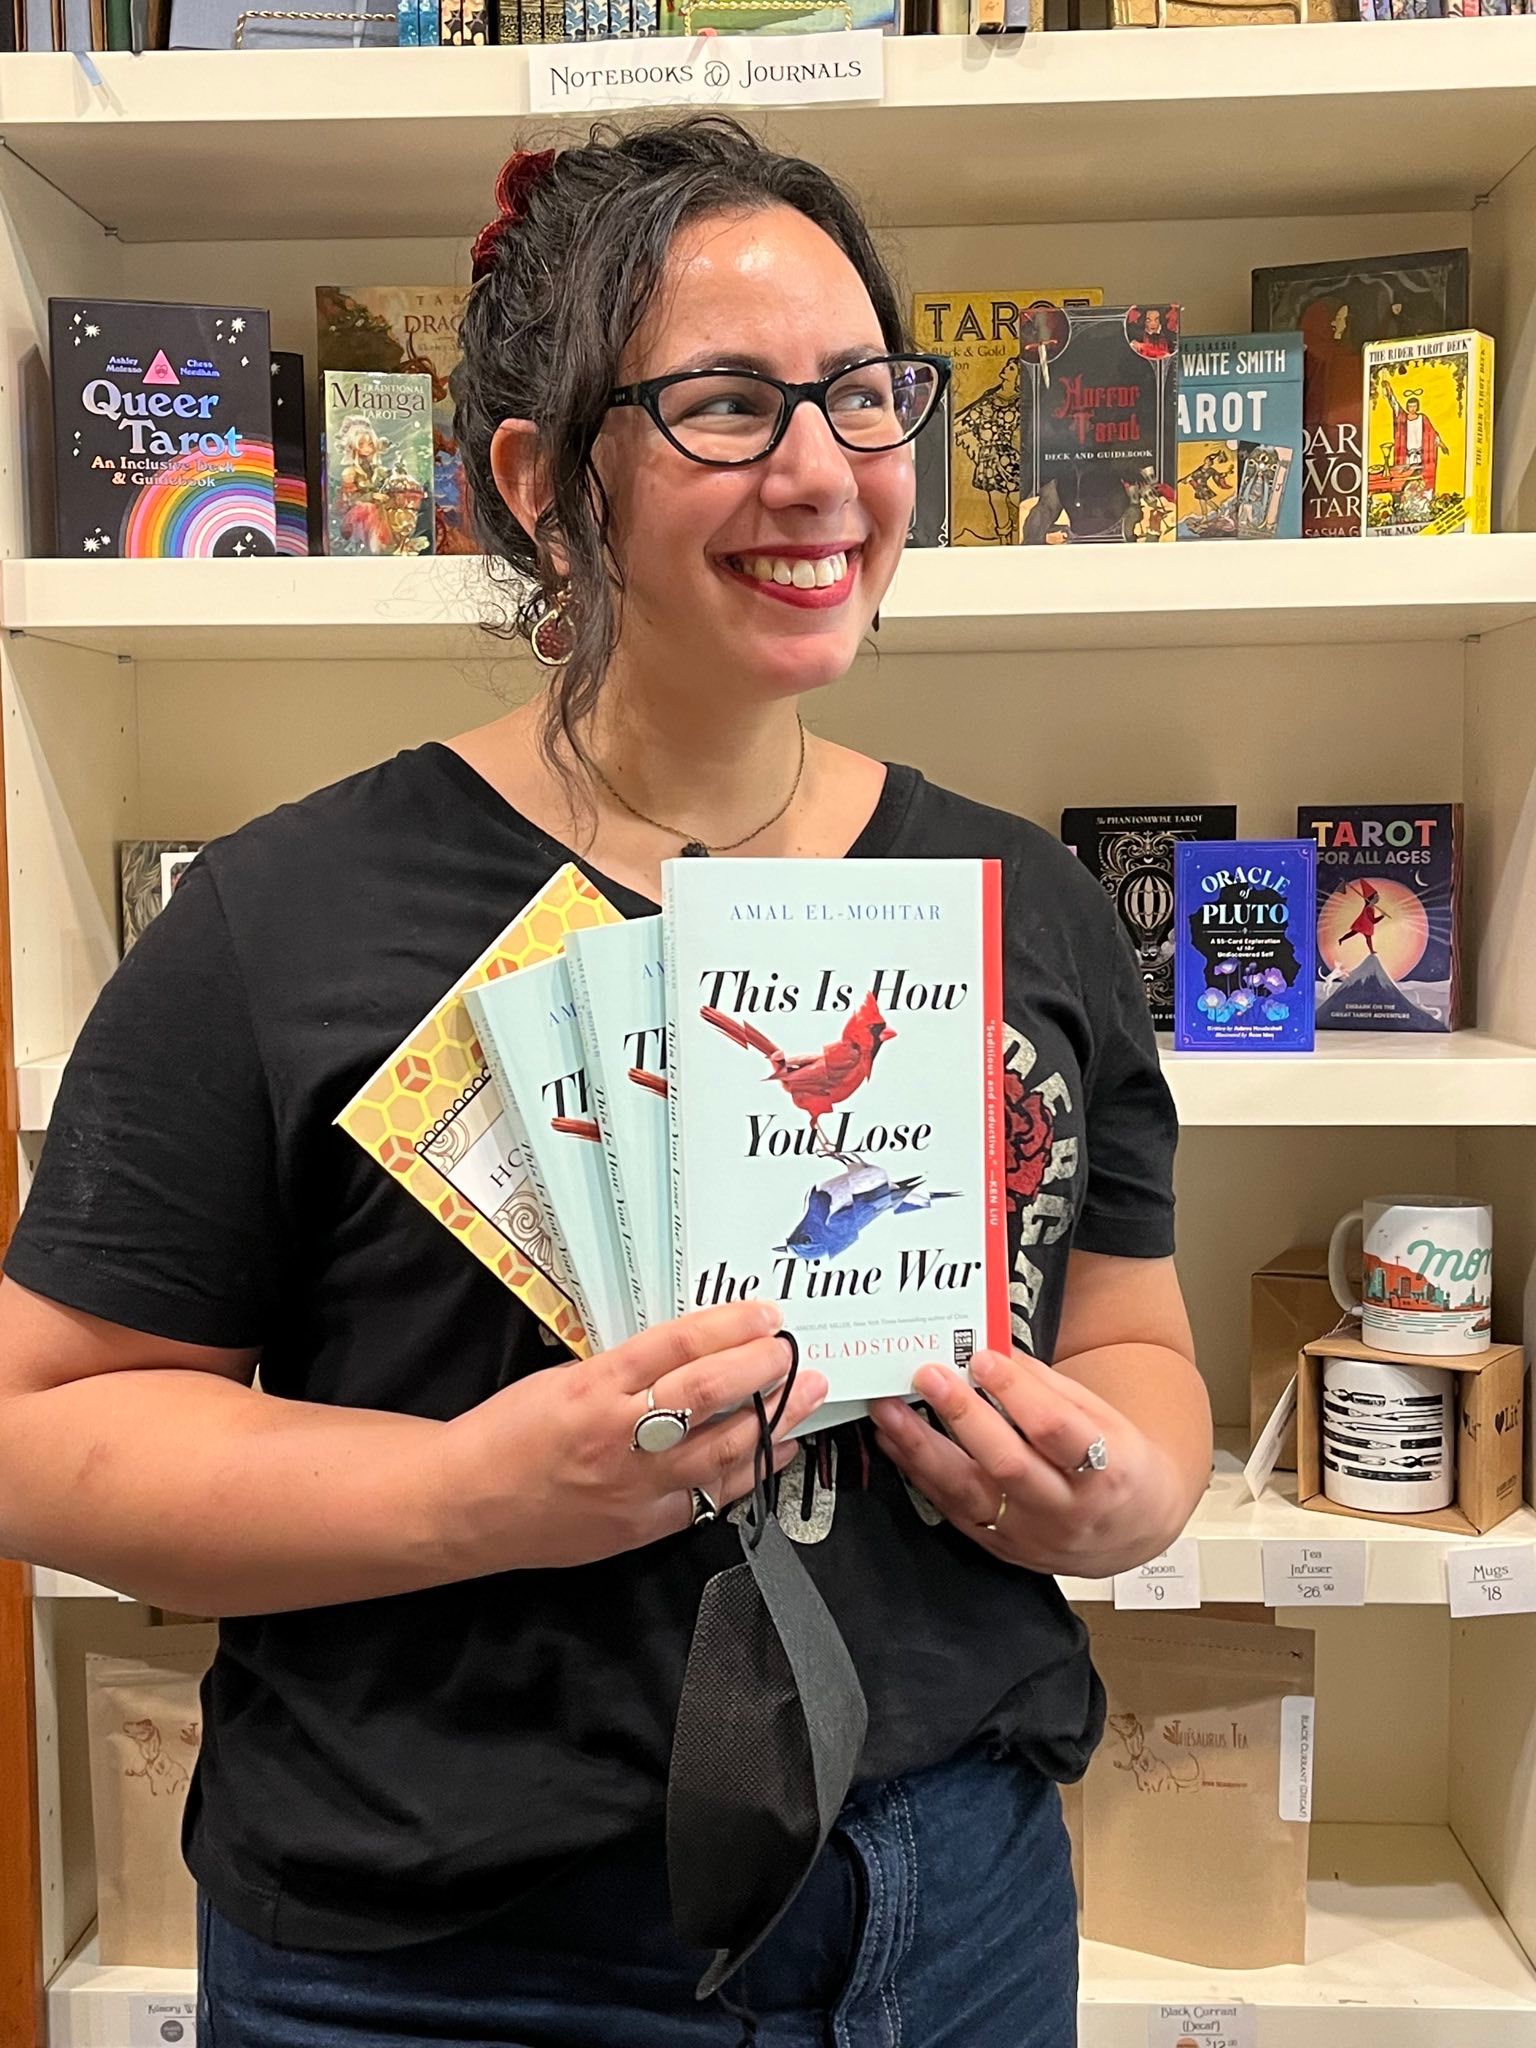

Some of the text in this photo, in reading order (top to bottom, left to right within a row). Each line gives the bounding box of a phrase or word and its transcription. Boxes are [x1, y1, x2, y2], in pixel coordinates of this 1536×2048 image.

[550, 64, 693, 95] NOTEBOOKS
[739, 60, 862, 89] JOURNALS
[978, 345, 1006, 356] Gold
[1195, 341, 1237, 352] CLASSIC
[1369, 350, 1385, 363] THE
[1388, 346, 1414, 359] RIDER
[1417, 342, 1444, 356] TAROT
[180, 367, 220, 378] Needham
[1182, 349, 1286, 377] WAITE SMITH
[82, 379, 219, 421] Queer
[332, 382, 425, 418] Manga
[363, 384, 424, 395] TRADITIONAL
[1052, 372, 1140, 418] Horror
[363, 409, 398, 421] TAROT
[1178, 390, 1268, 435] AROT
[118, 418, 243, 458] Tarot
[1067, 411, 1141, 446] Tarot
[1302, 424, 1361, 456] AR
[91, 456, 236, 473] An Inclusive Deck
[1045, 450, 1153, 461] DECK AND GUIDEBOOK
[112, 472, 216, 487] & Guidebook
[1302, 457, 1361, 497] WO
[1310, 497, 1361, 519] TAR
[1107, 815, 1173, 825] PHANTOMWISE
[1175, 814, 1202, 823] TAROT
[1311, 820, 1437, 847] TAROT
[1316, 850, 1431, 865] FOR ALL AGES
[1201, 866, 1291, 894] ORACLE
[1239, 887, 1253, 899] of
[729, 904, 942, 921] AMAL EL-MOHTAR
[1202, 903, 1289, 925] PLUTO
[700, 969, 799, 1013] This
[811, 969, 853, 1013] Is
[871, 969, 968, 1012] How
[987, 1079, 997, 1100] and
[594, 1086, 608, 1125] This
[603, 1131, 612, 1146] Is
[744, 1111, 932, 1158] You Lose
[607, 1152, 620, 1193] How
[615, 1198, 627, 1227] You
[989, 1208, 999, 1226] LIU
[520, 1140, 600, 1347] This Is How You Lose the
[621, 1232, 636, 1274] Lose
[694, 1248, 982, 1307] the Time War
[631, 1277, 642, 1302] the
[807, 1333, 941, 1361] GLADSTONE
[1300, 1549, 1322, 1561] Tea
[1141, 1565, 1176, 1576] Spoon
[1291, 1563, 1332, 1576] Infuser
[1473, 1565, 1509, 1581] Mugs
[1146, 1583, 1165, 1600] $9
[1481, 1584, 1502, 1601] $18
[1300, 1714, 1310, 1741] BLACK
[1299, 1742, 1310, 1782] CURRANT
[1161, 2006, 1237, 2019] Black Currant
[1182, 2020, 1221, 2033] (Decaf)
